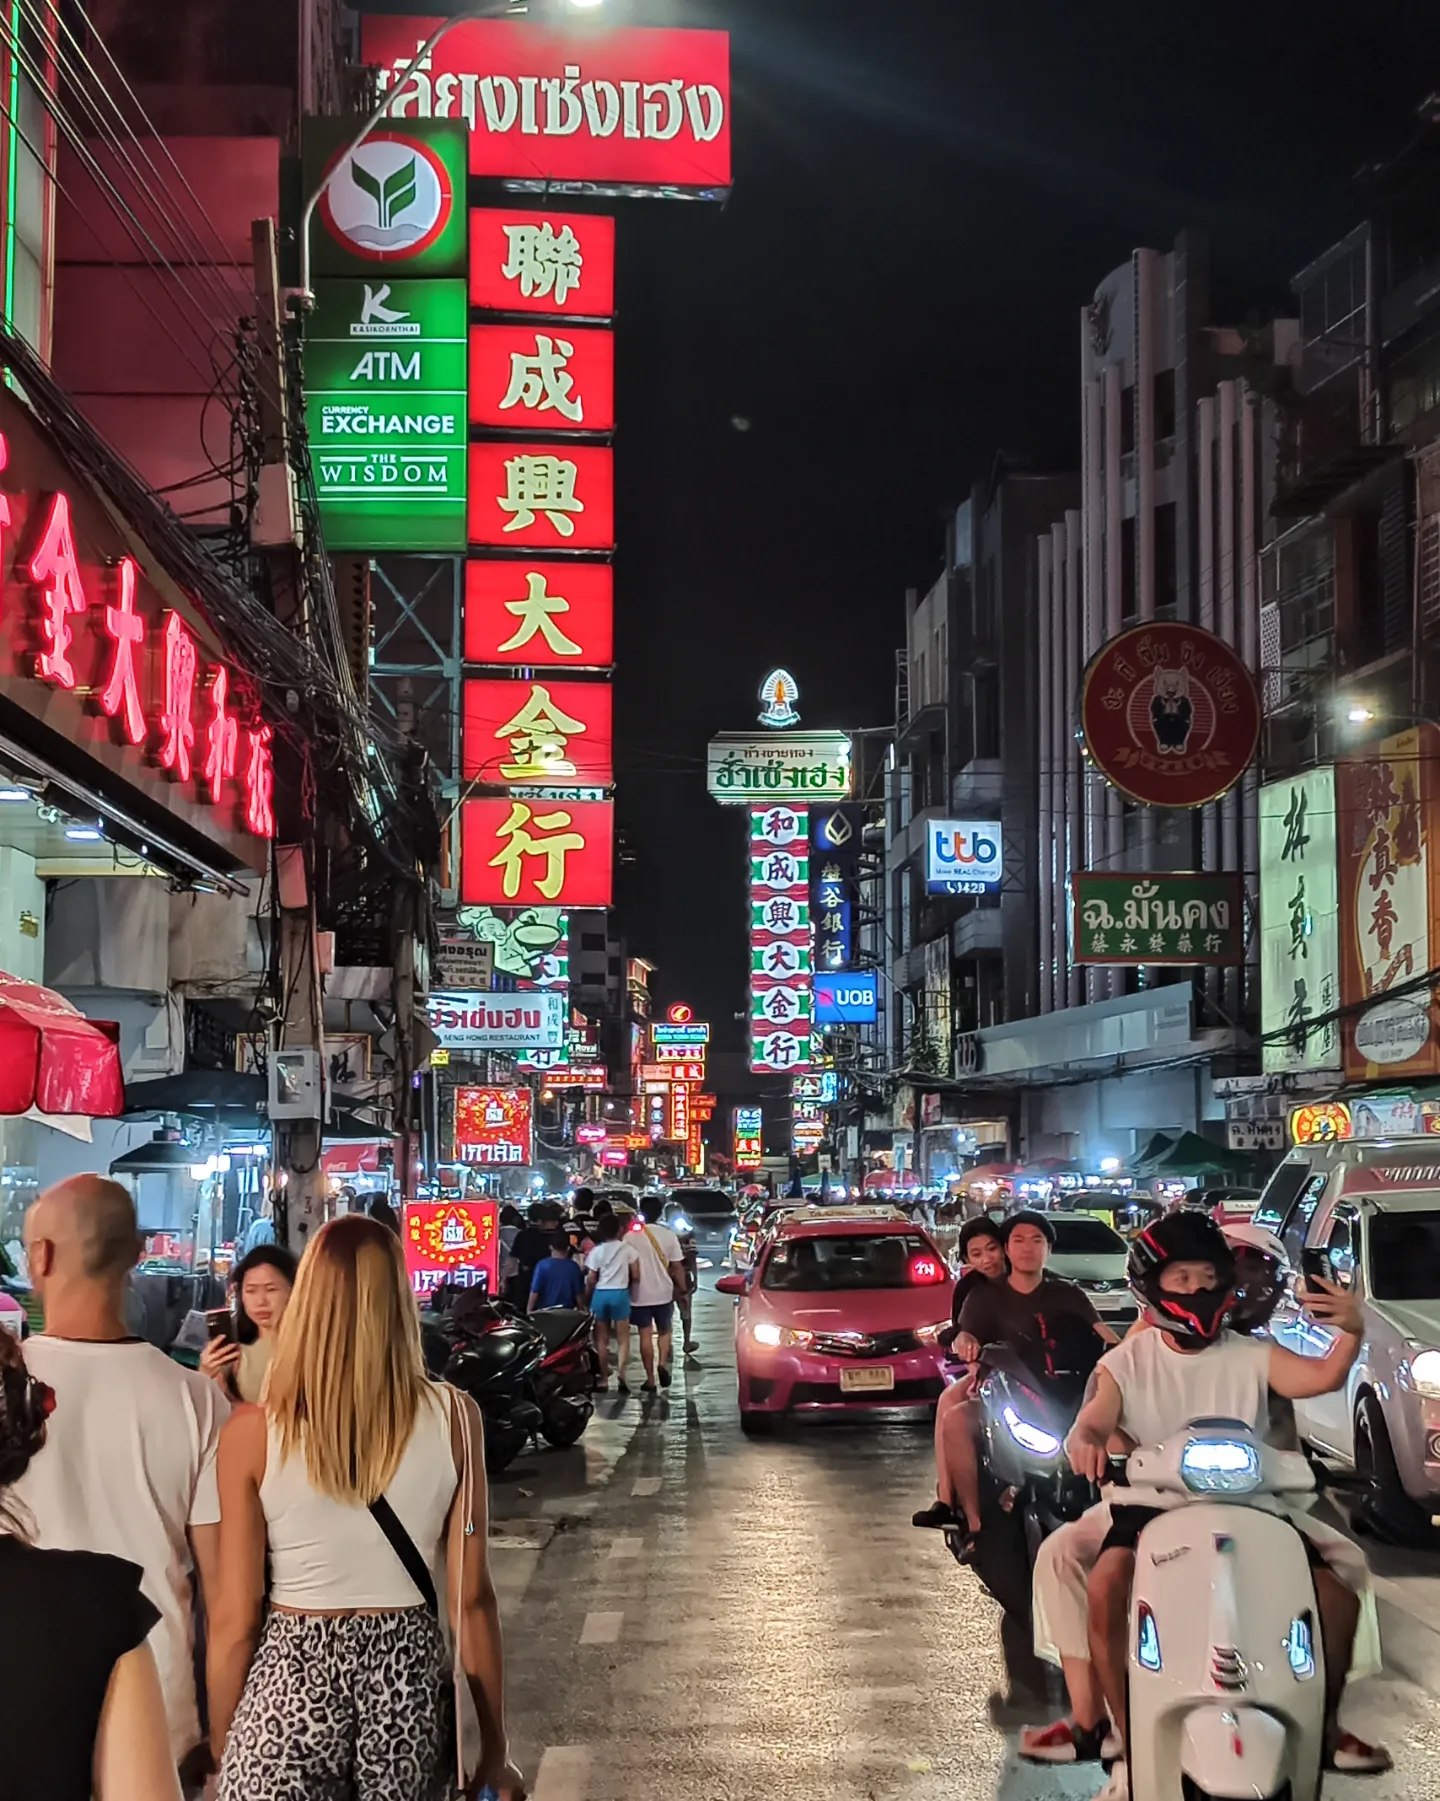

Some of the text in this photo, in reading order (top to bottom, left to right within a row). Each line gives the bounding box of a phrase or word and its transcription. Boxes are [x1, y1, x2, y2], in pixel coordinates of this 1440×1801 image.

[352, 325, 418, 333] KASIKORNTHAI
[350, 352, 420, 380] ATM
[322, 406, 368, 414] CURRENCY
[322, 415, 454, 434] EXCHANGE
[371, 454, 396, 463] THE
[320, 465, 448, 482] WISDOM
[936, 831, 996, 863] ttb
[1083, 880, 1229, 929] ฉ.มั่นคง
[766, 810, 796, 1065] 和成興大金行
[836, 989, 874, 1005] UOB
